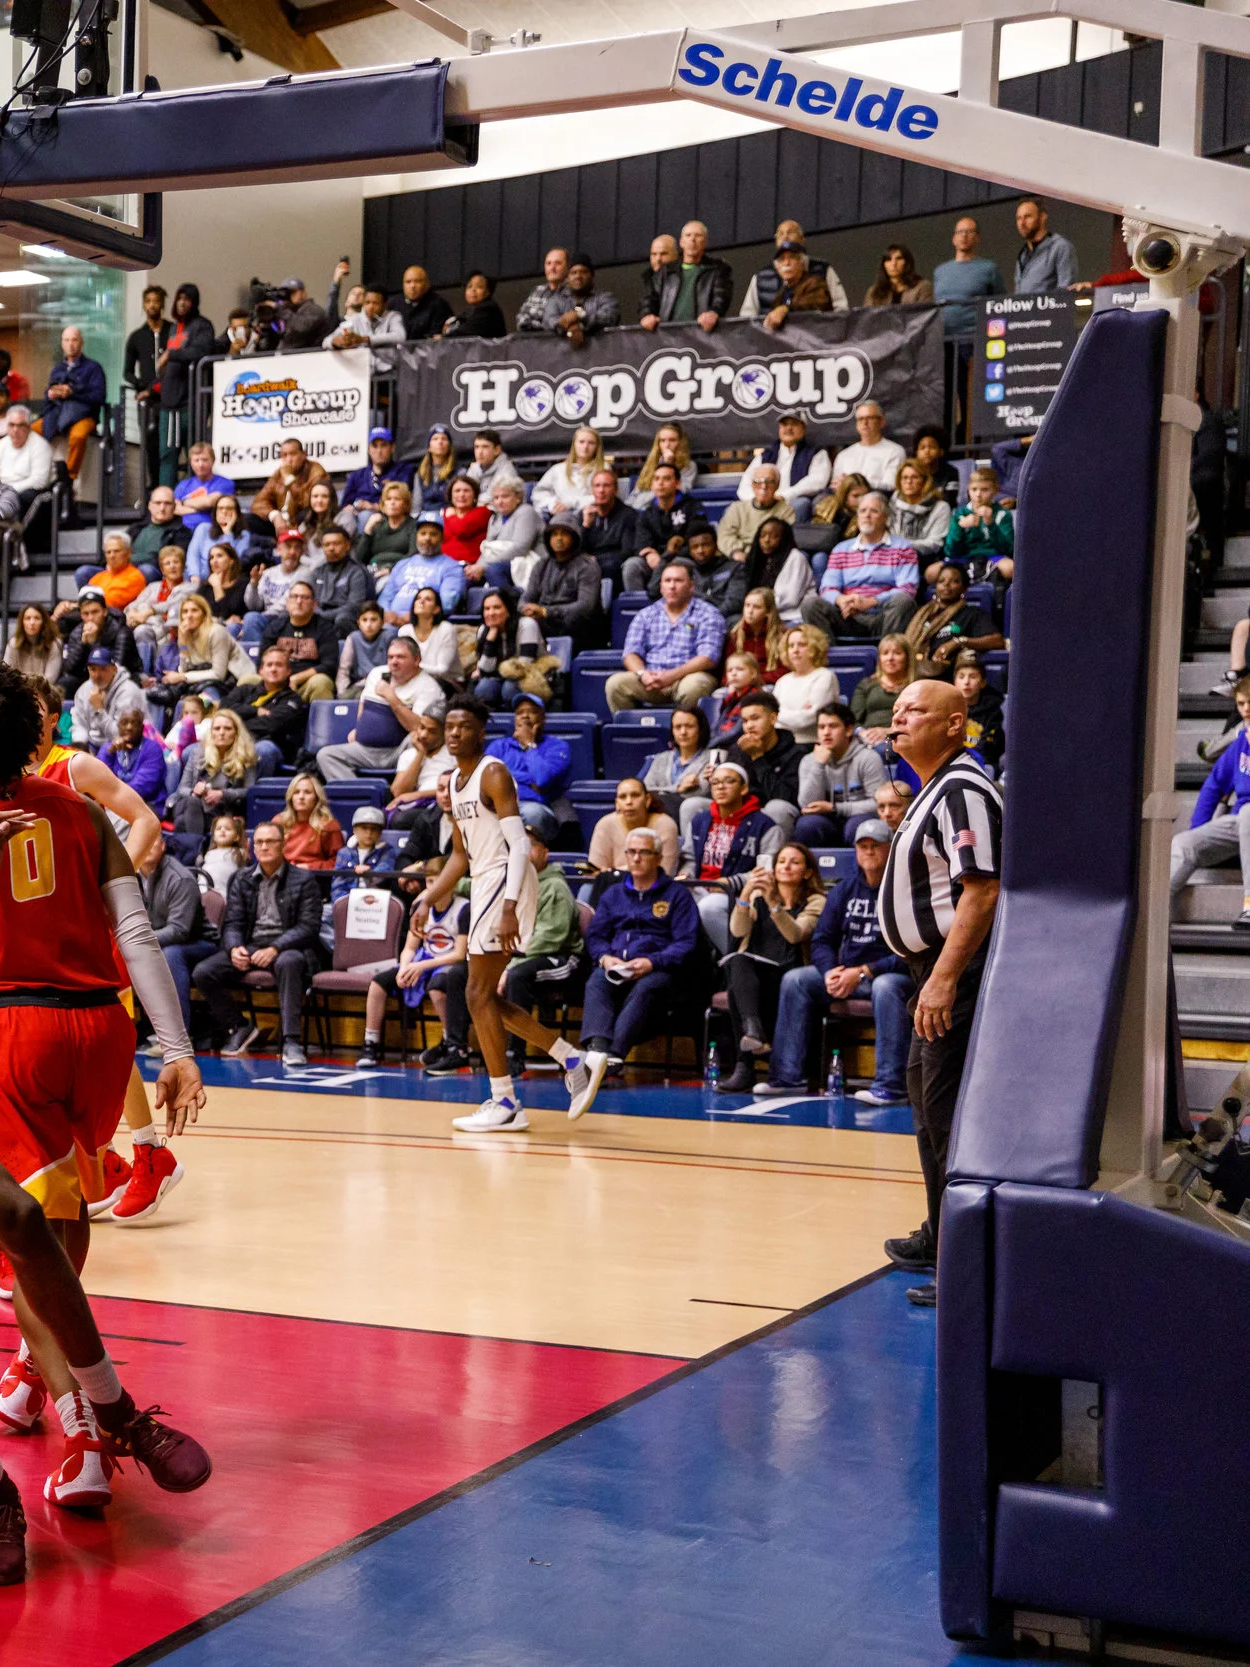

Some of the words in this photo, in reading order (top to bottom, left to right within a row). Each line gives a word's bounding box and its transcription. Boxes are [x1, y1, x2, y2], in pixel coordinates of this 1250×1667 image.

[678, 43, 939, 140] Schelde
[985, 299, 1033, 314] Follow
[282, 409, 355, 428] Showcase
[1005, 414, 1044, 427] Grou
[8, 817, 56, 903] 0
